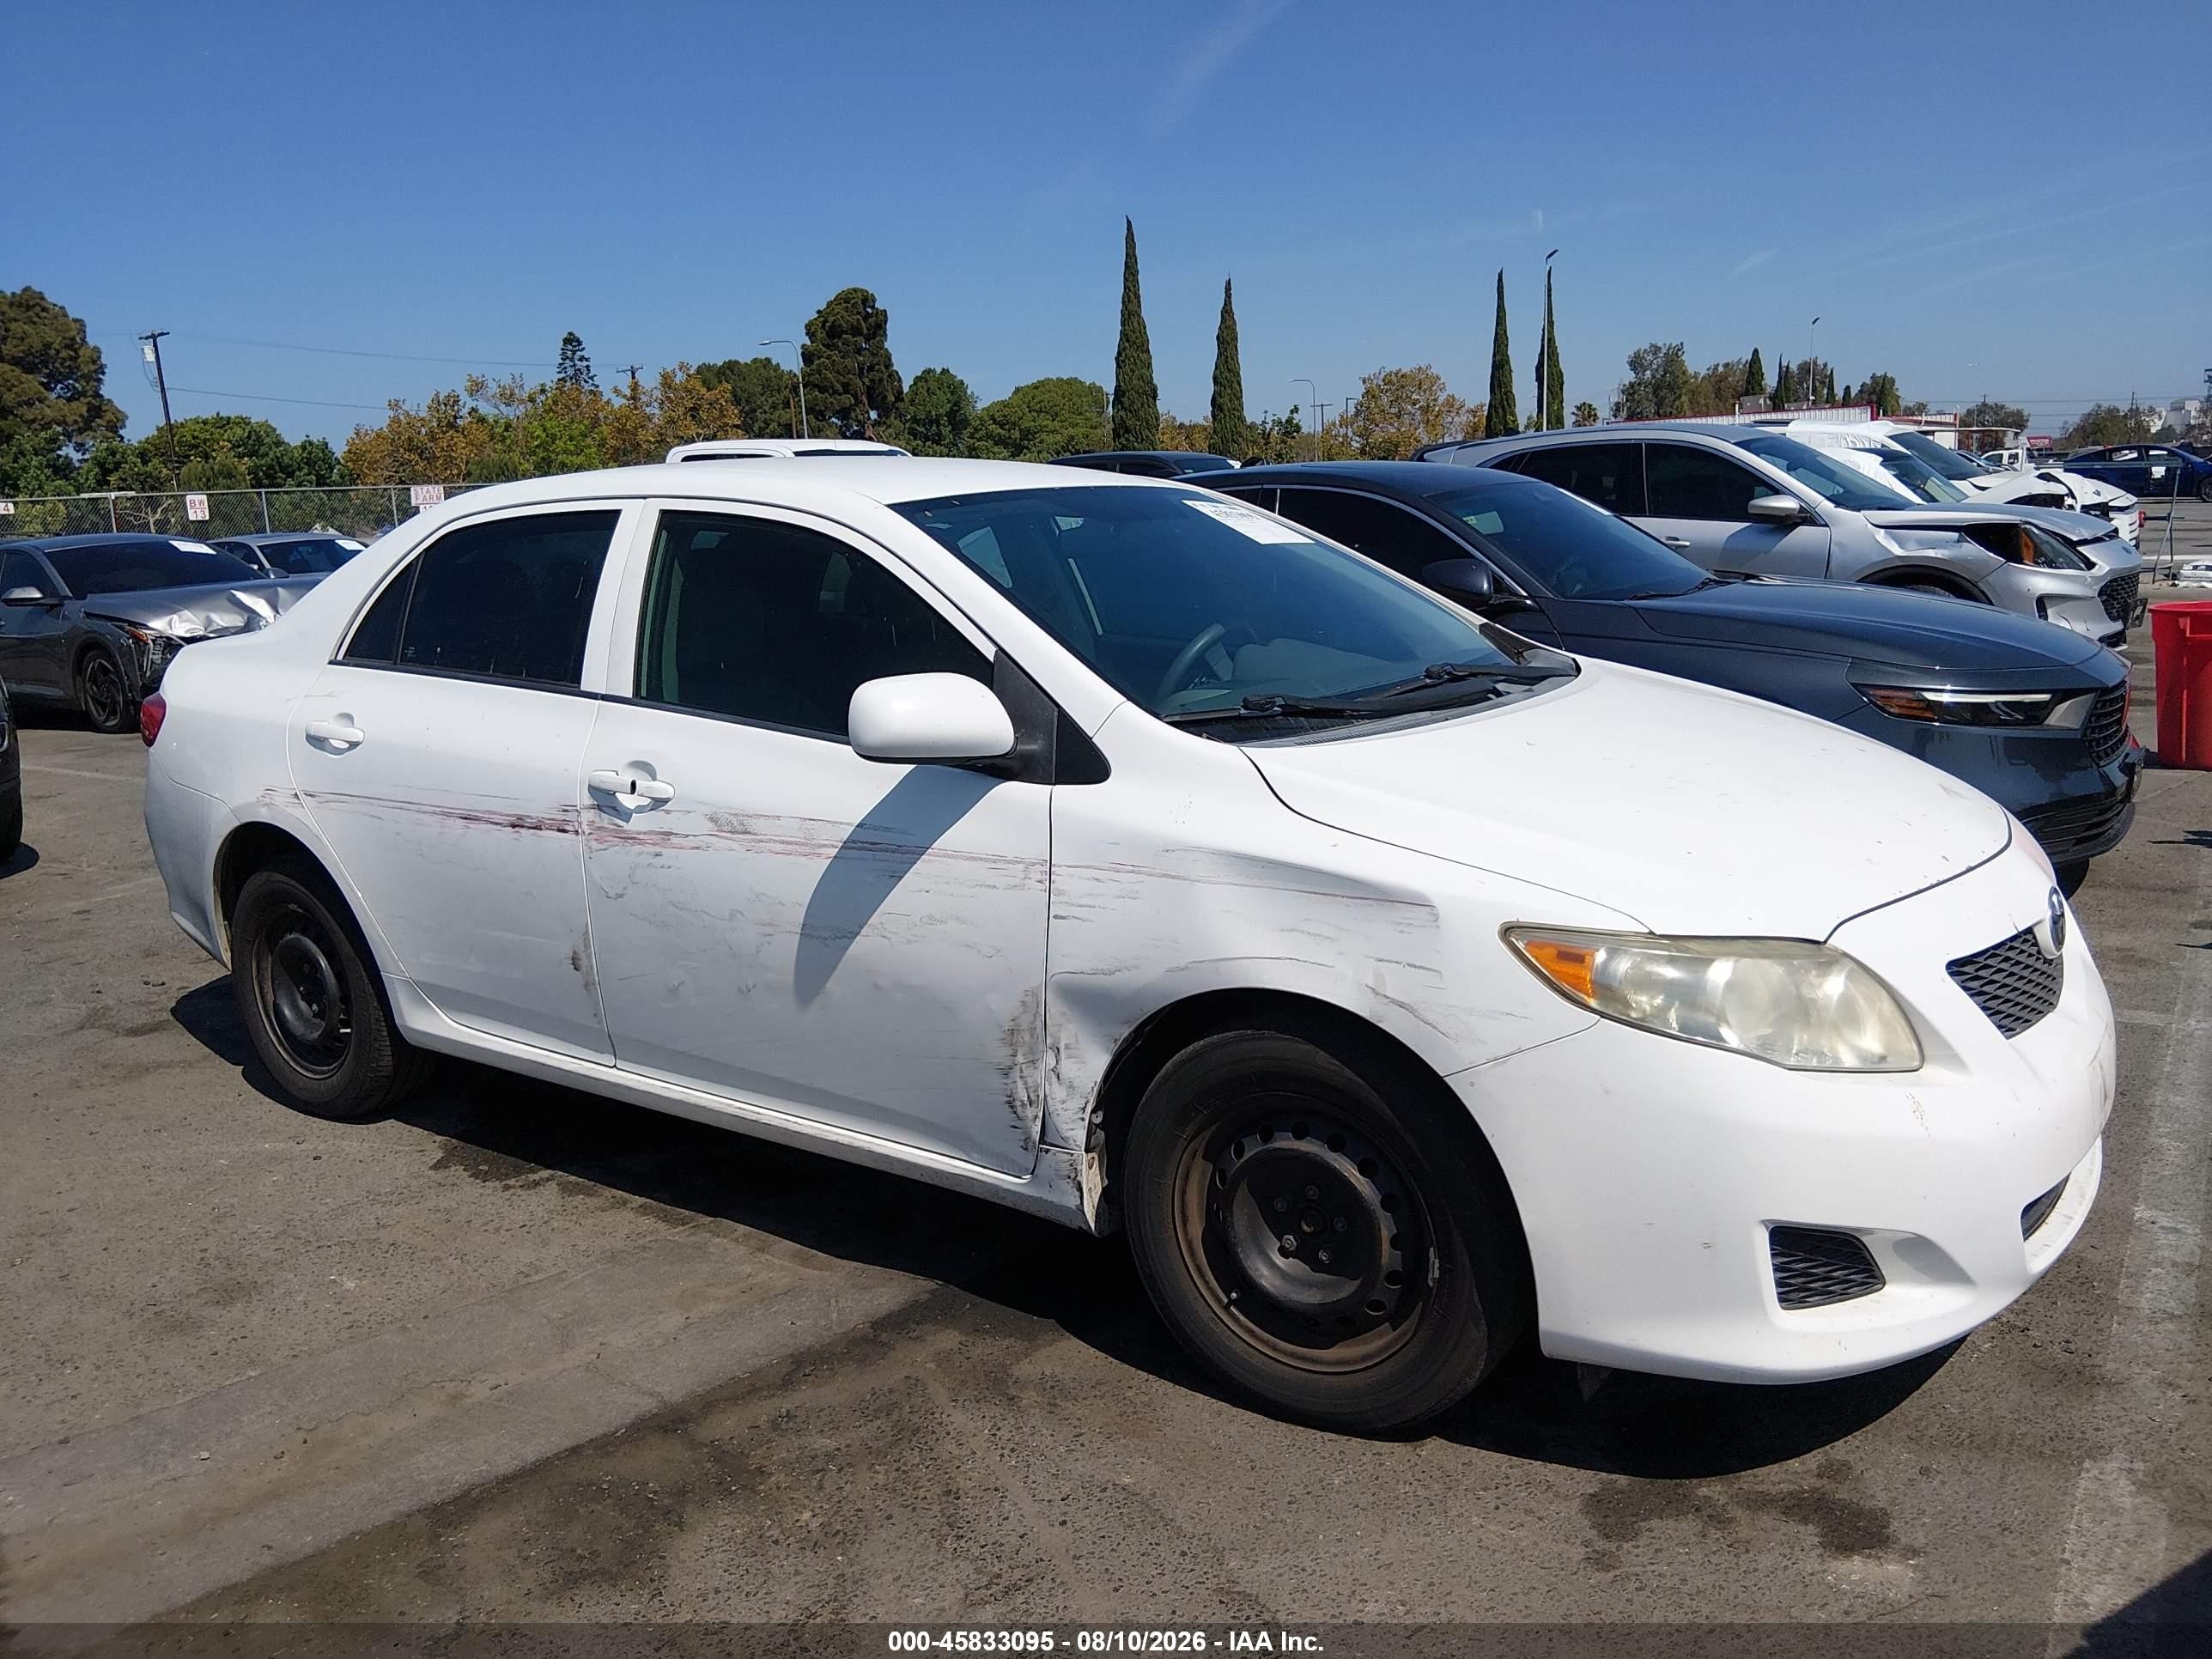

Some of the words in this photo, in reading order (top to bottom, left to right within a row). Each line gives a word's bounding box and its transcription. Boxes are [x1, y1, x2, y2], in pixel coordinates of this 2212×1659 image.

[413, 486, 443, 495] STATE
[189, 499, 205, 508] BW
[192, 510, 207, 520] 13
